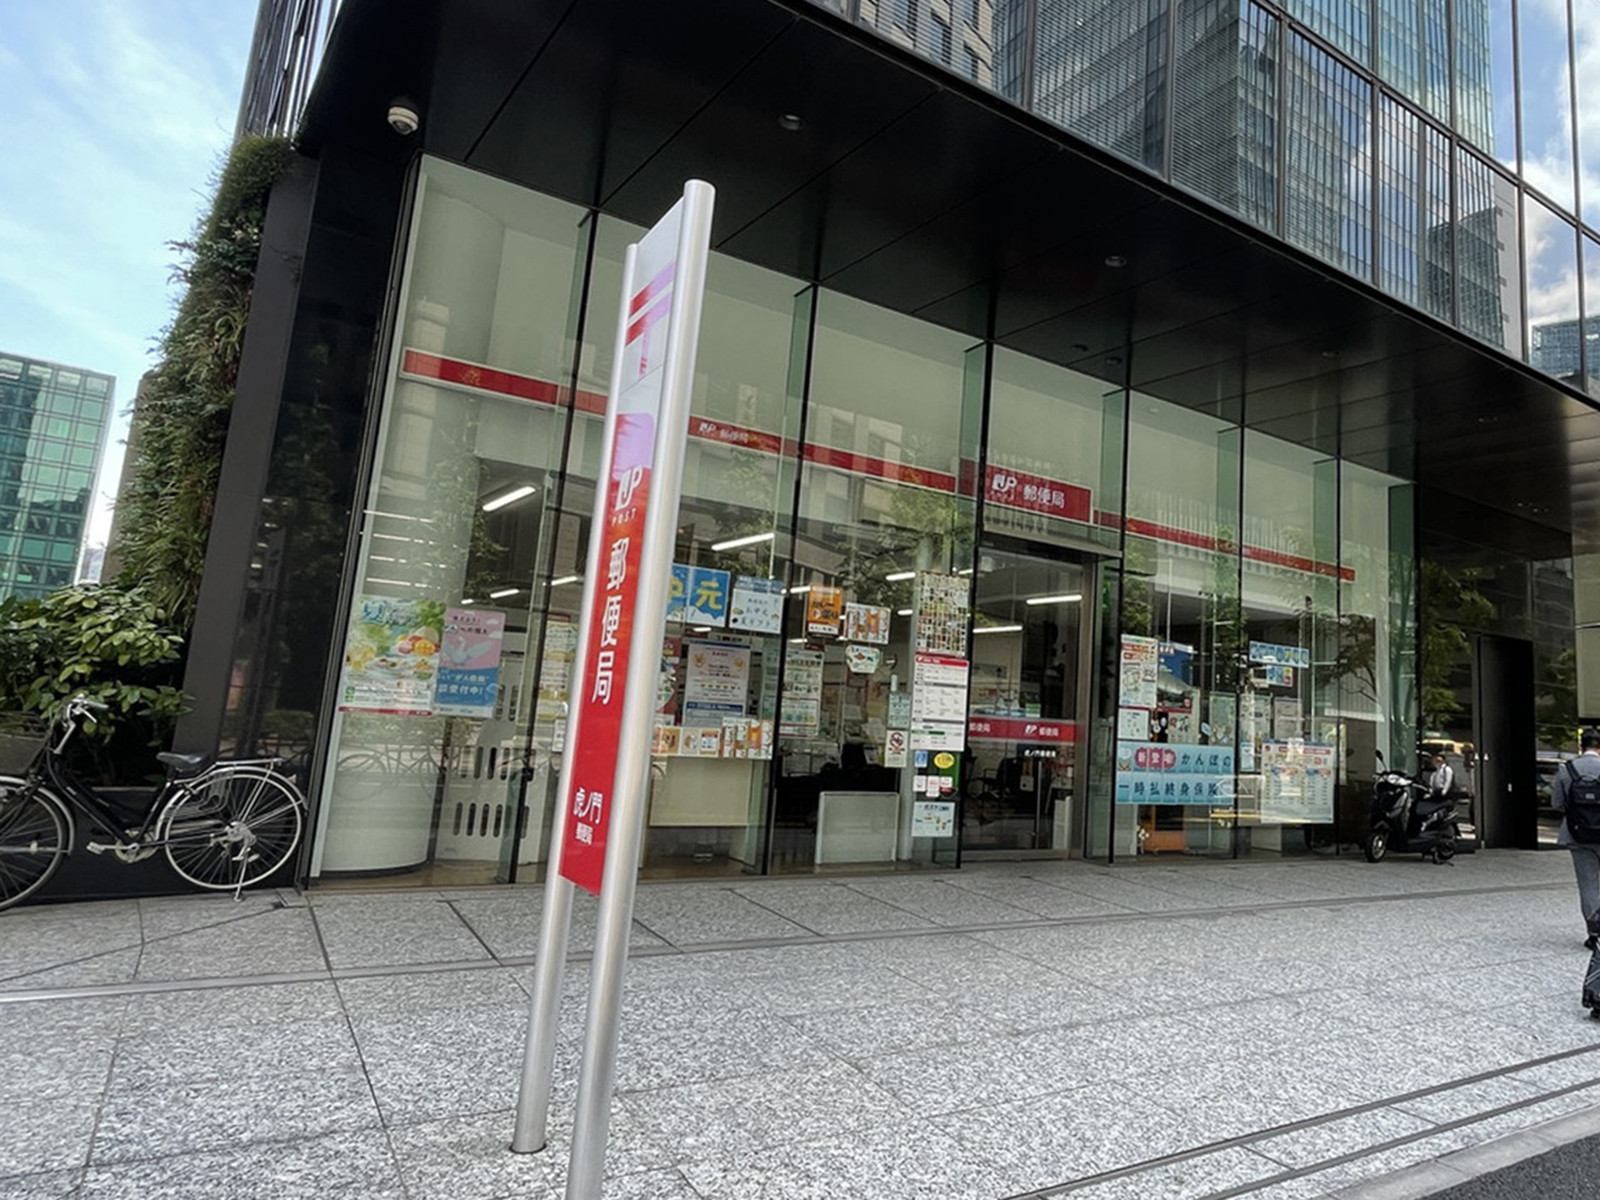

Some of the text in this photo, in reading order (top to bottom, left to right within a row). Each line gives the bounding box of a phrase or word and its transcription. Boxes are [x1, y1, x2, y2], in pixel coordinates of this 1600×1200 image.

[615, 464, 643, 511] JP
[991, 473, 1018, 493] JP
[1023, 484, 1065, 509] 郵便局
[611, 507, 637, 528] POST
[591, 537, 630, 705] 郵便局
